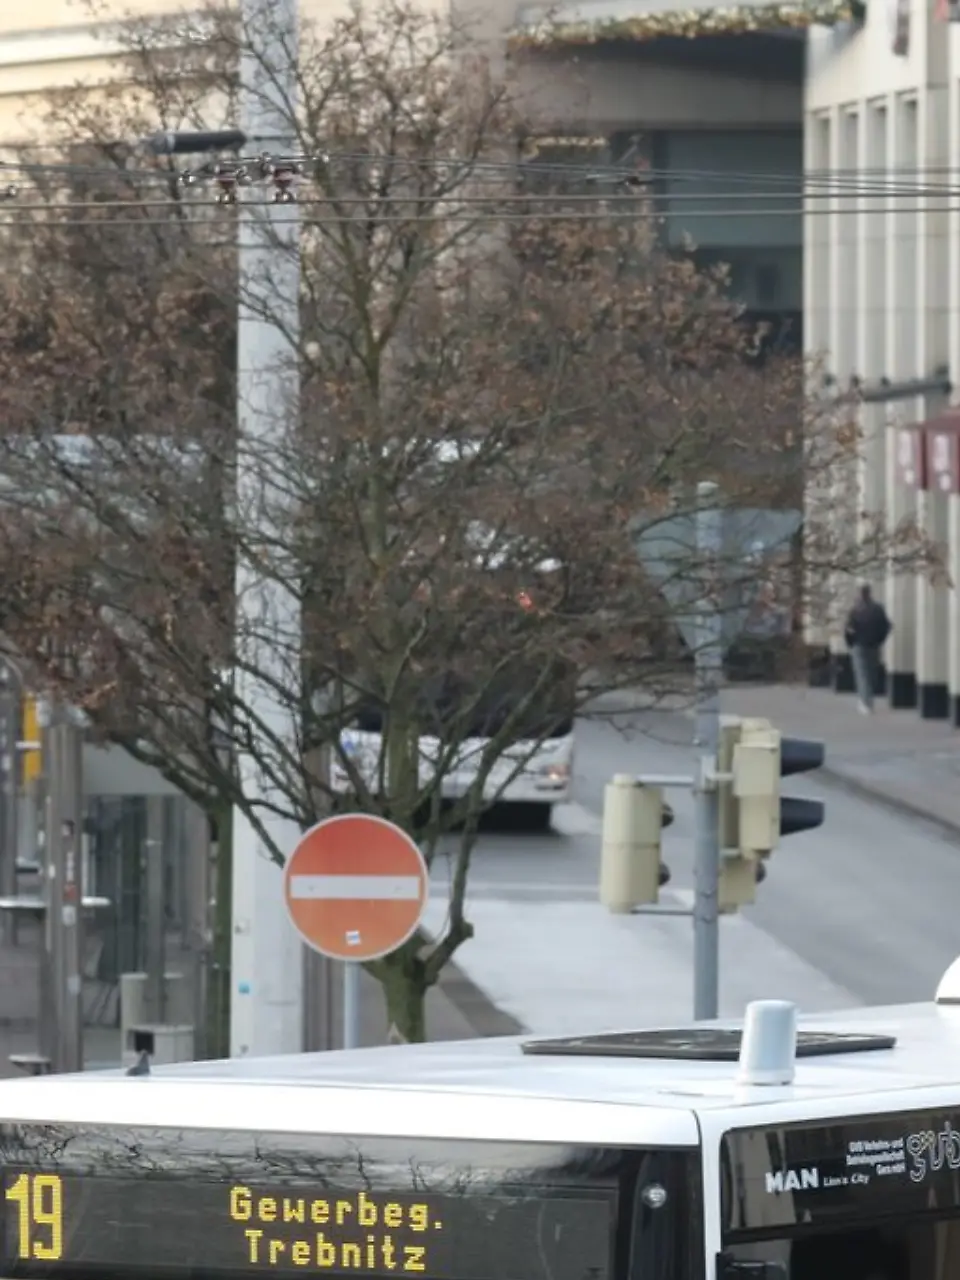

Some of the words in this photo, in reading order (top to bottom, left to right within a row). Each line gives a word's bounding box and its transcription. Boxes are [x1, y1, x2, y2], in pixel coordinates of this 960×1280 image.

[765, 1167, 819, 1193] MAN
[5, 1173, 63, 1261] 19
[229, 1186, 443, 1231] Gewerbeg.
[244, 1230, 426, 1271] Trebnitz
